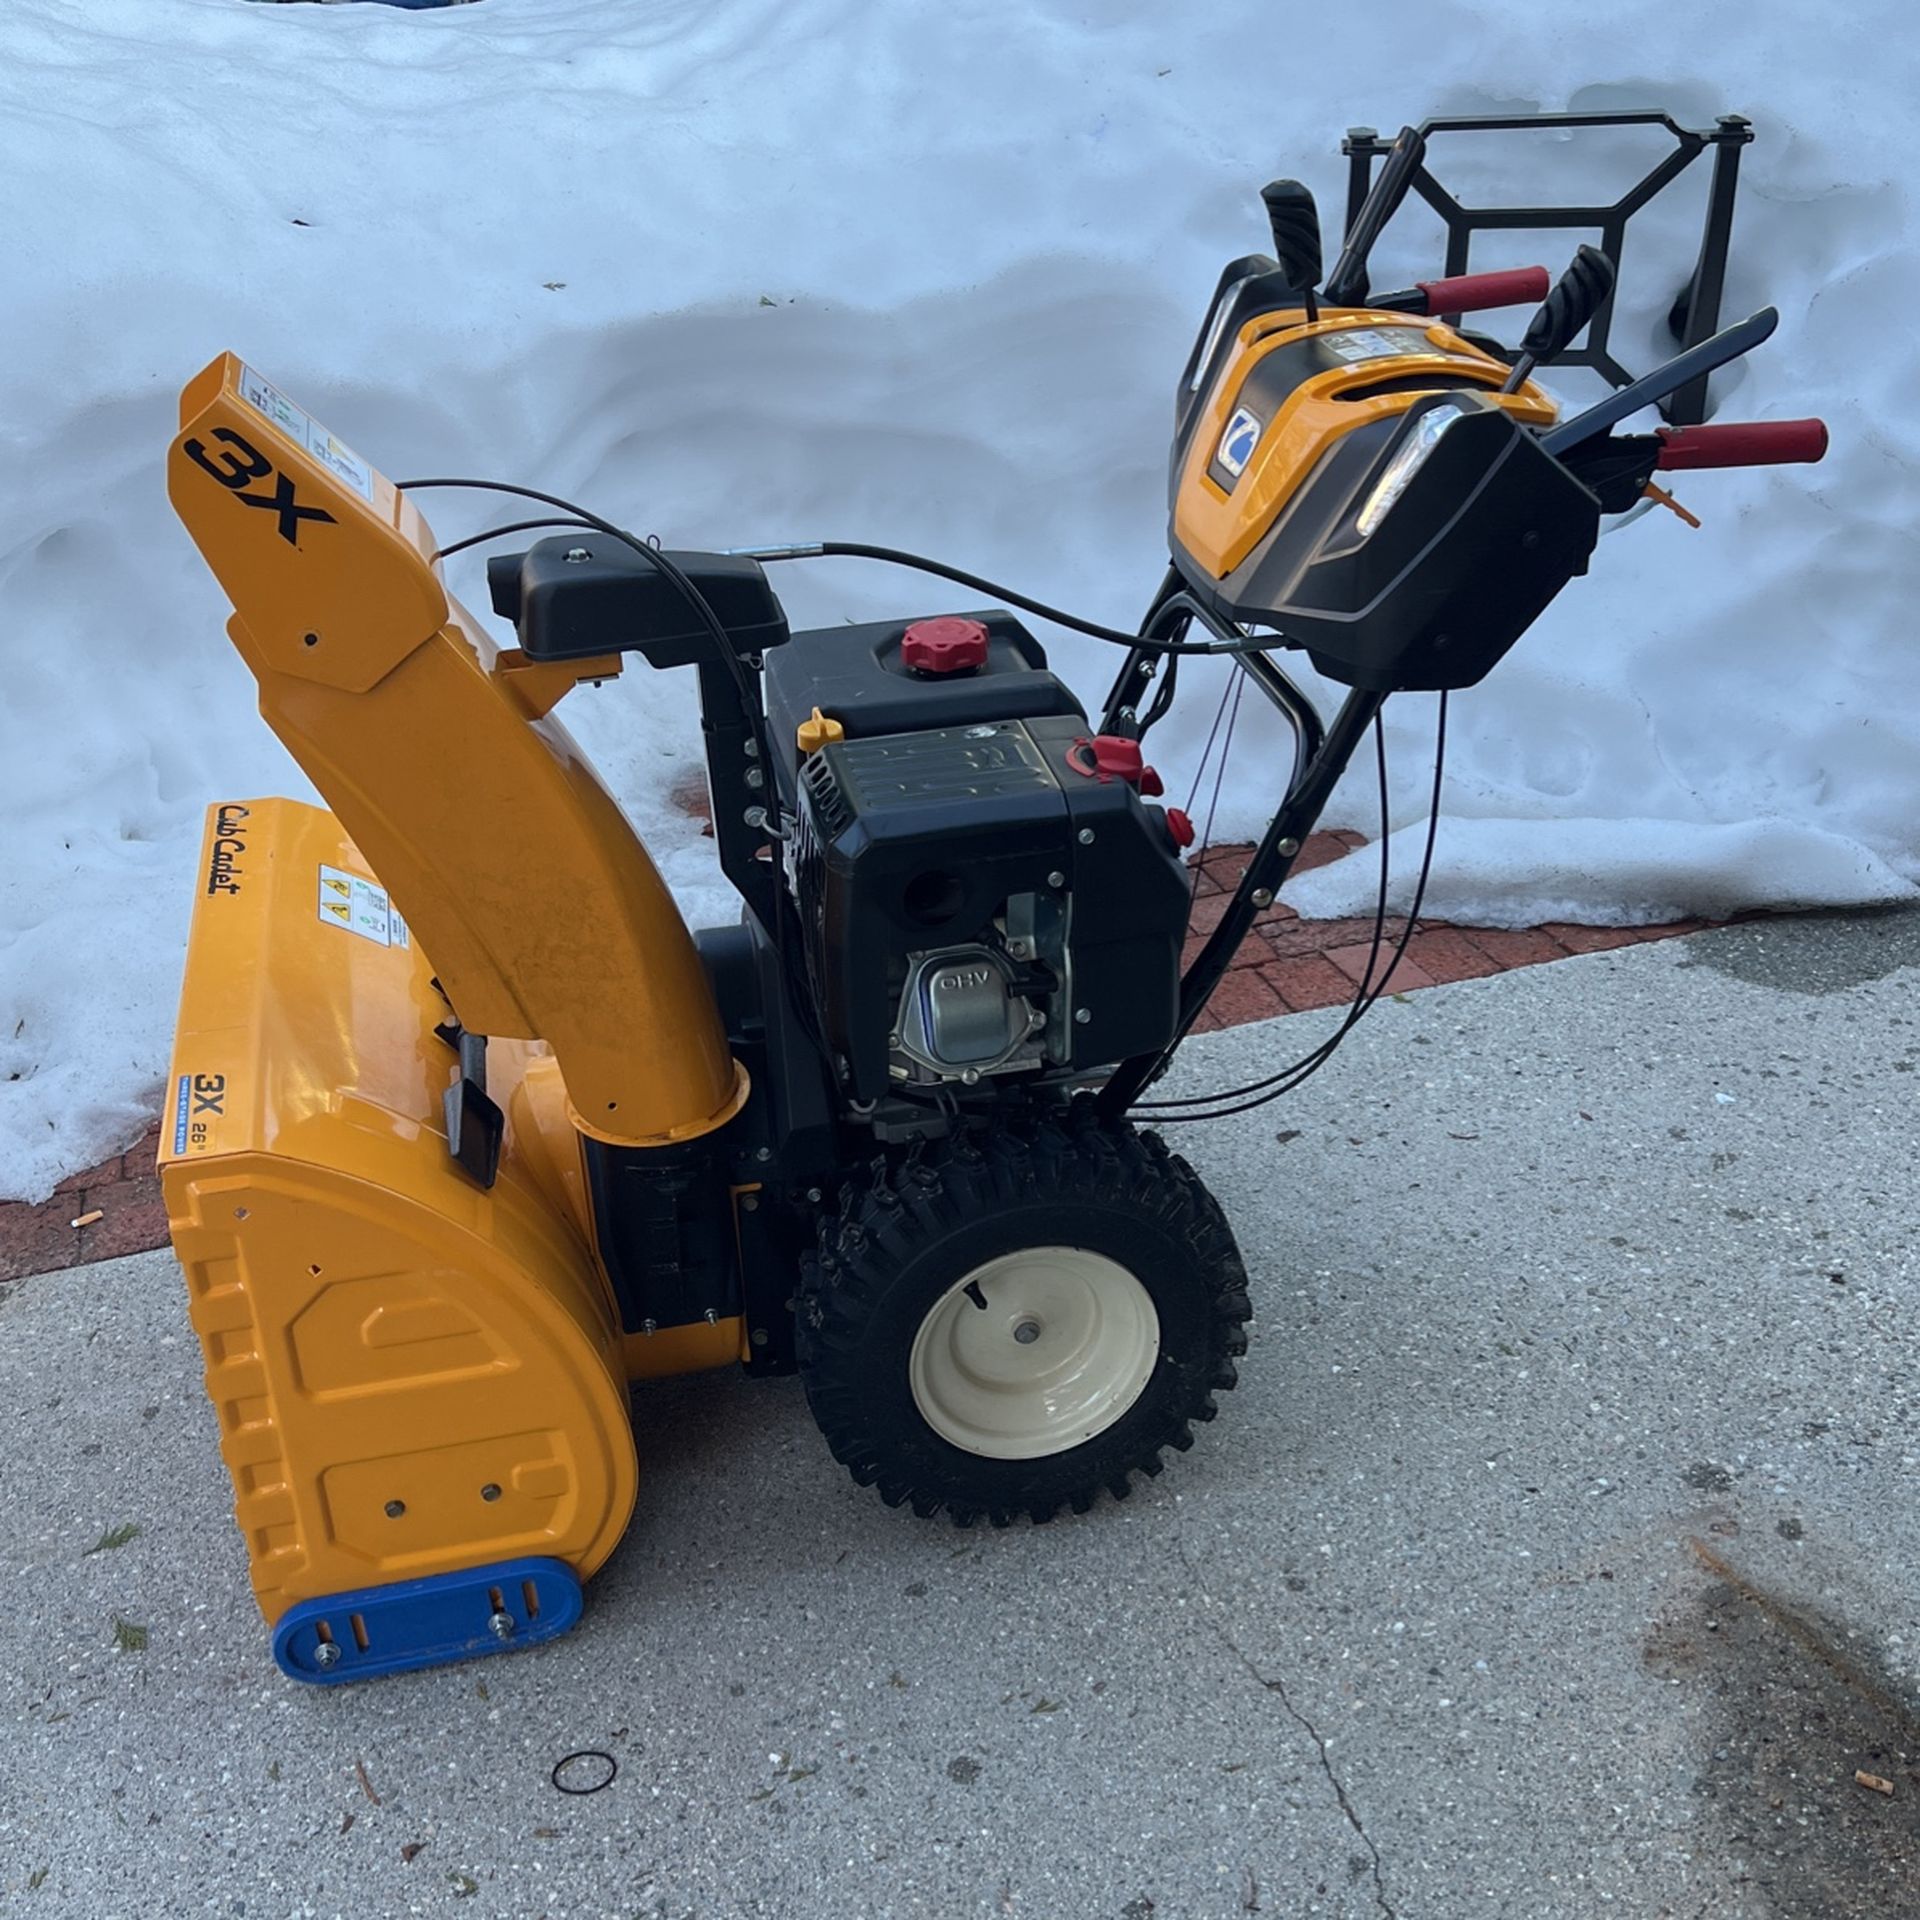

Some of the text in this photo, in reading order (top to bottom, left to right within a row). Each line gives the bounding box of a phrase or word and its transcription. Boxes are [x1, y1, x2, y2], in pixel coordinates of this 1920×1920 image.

[183, 427, 340, 547] 3X
[208, 805, 249, 895] Cub Cadet
[940, 970, 989, 989] OHV
[193, 1074, 225, 1115] 3X
[175, 1126, 187, 1153] POWER
